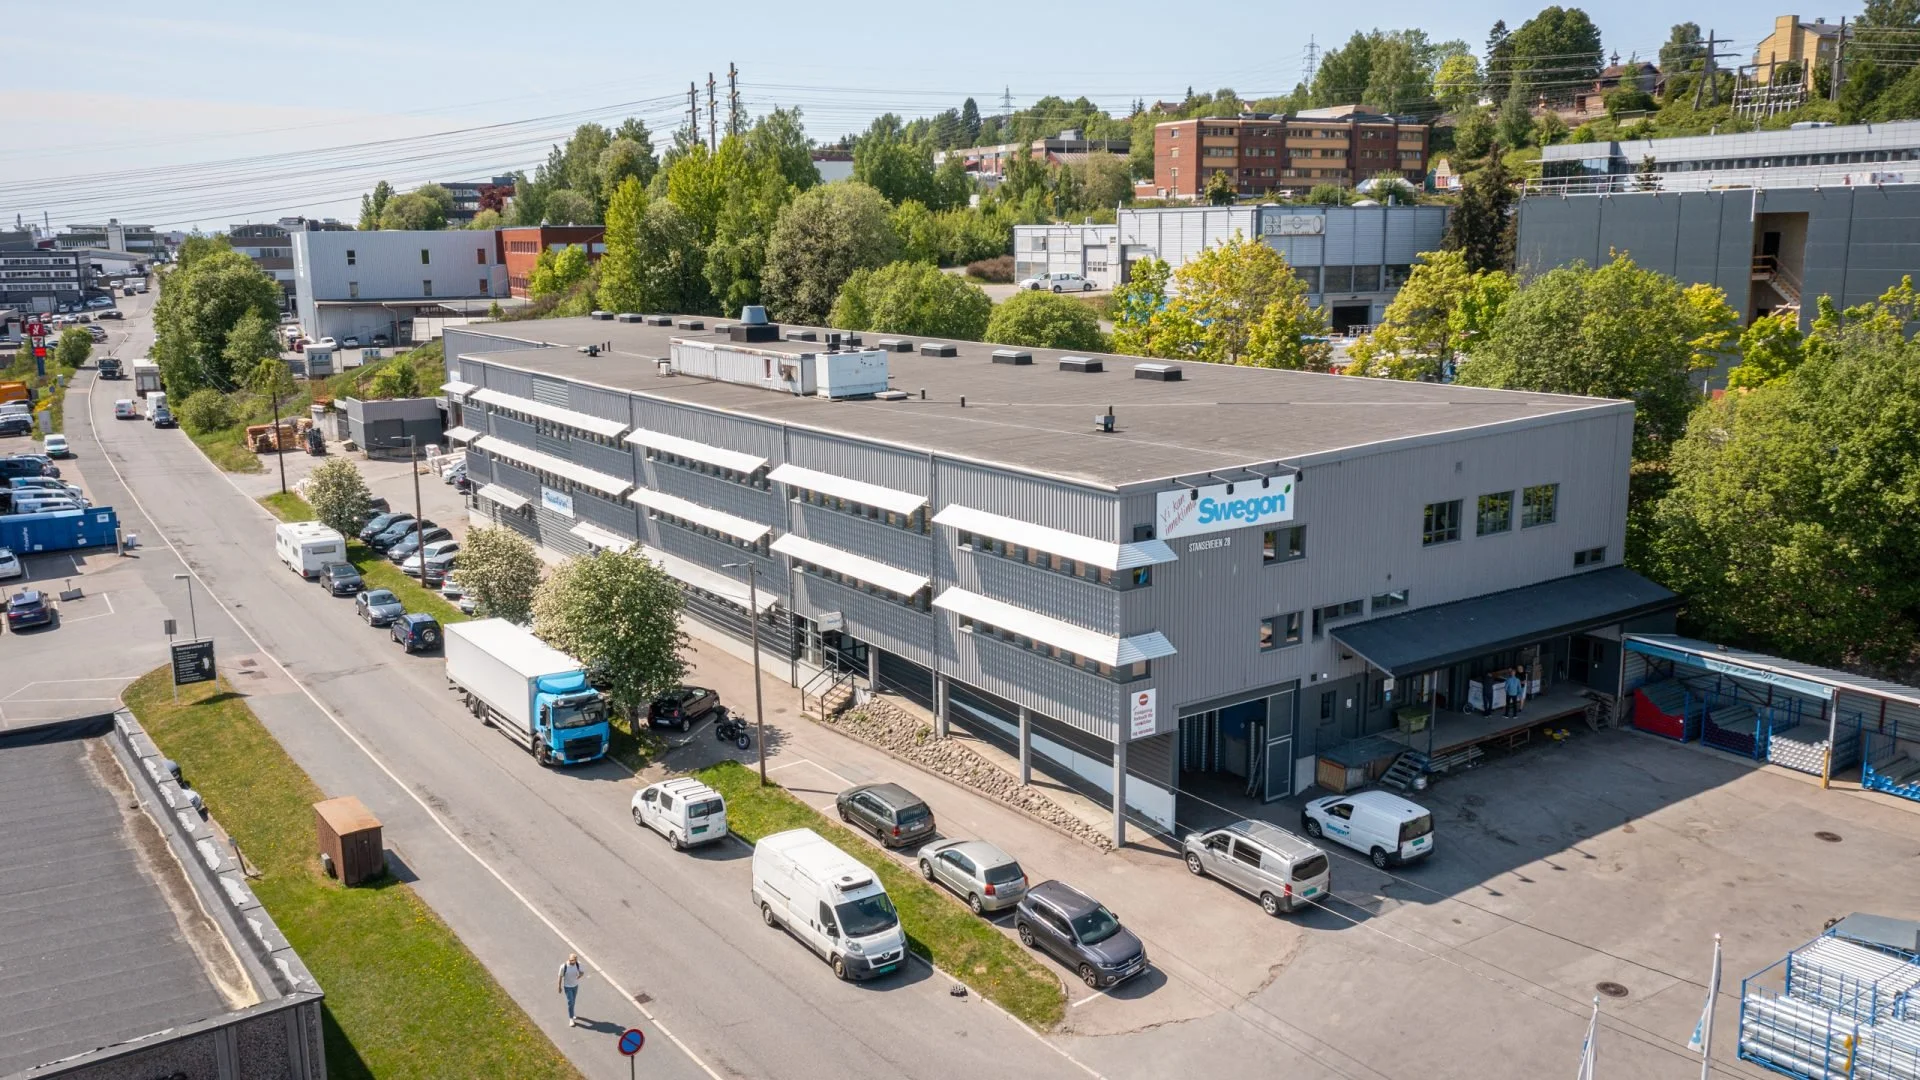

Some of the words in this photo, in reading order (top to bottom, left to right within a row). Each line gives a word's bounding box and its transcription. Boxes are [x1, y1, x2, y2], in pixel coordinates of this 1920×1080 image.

[1198, 493, 1286, 524] Swegon
[1189, 540, 1222, 552] STANSEVEIEN
[1224, 537, 1231, 548] 28
[1326, 822, 1347, 837] Swegon
